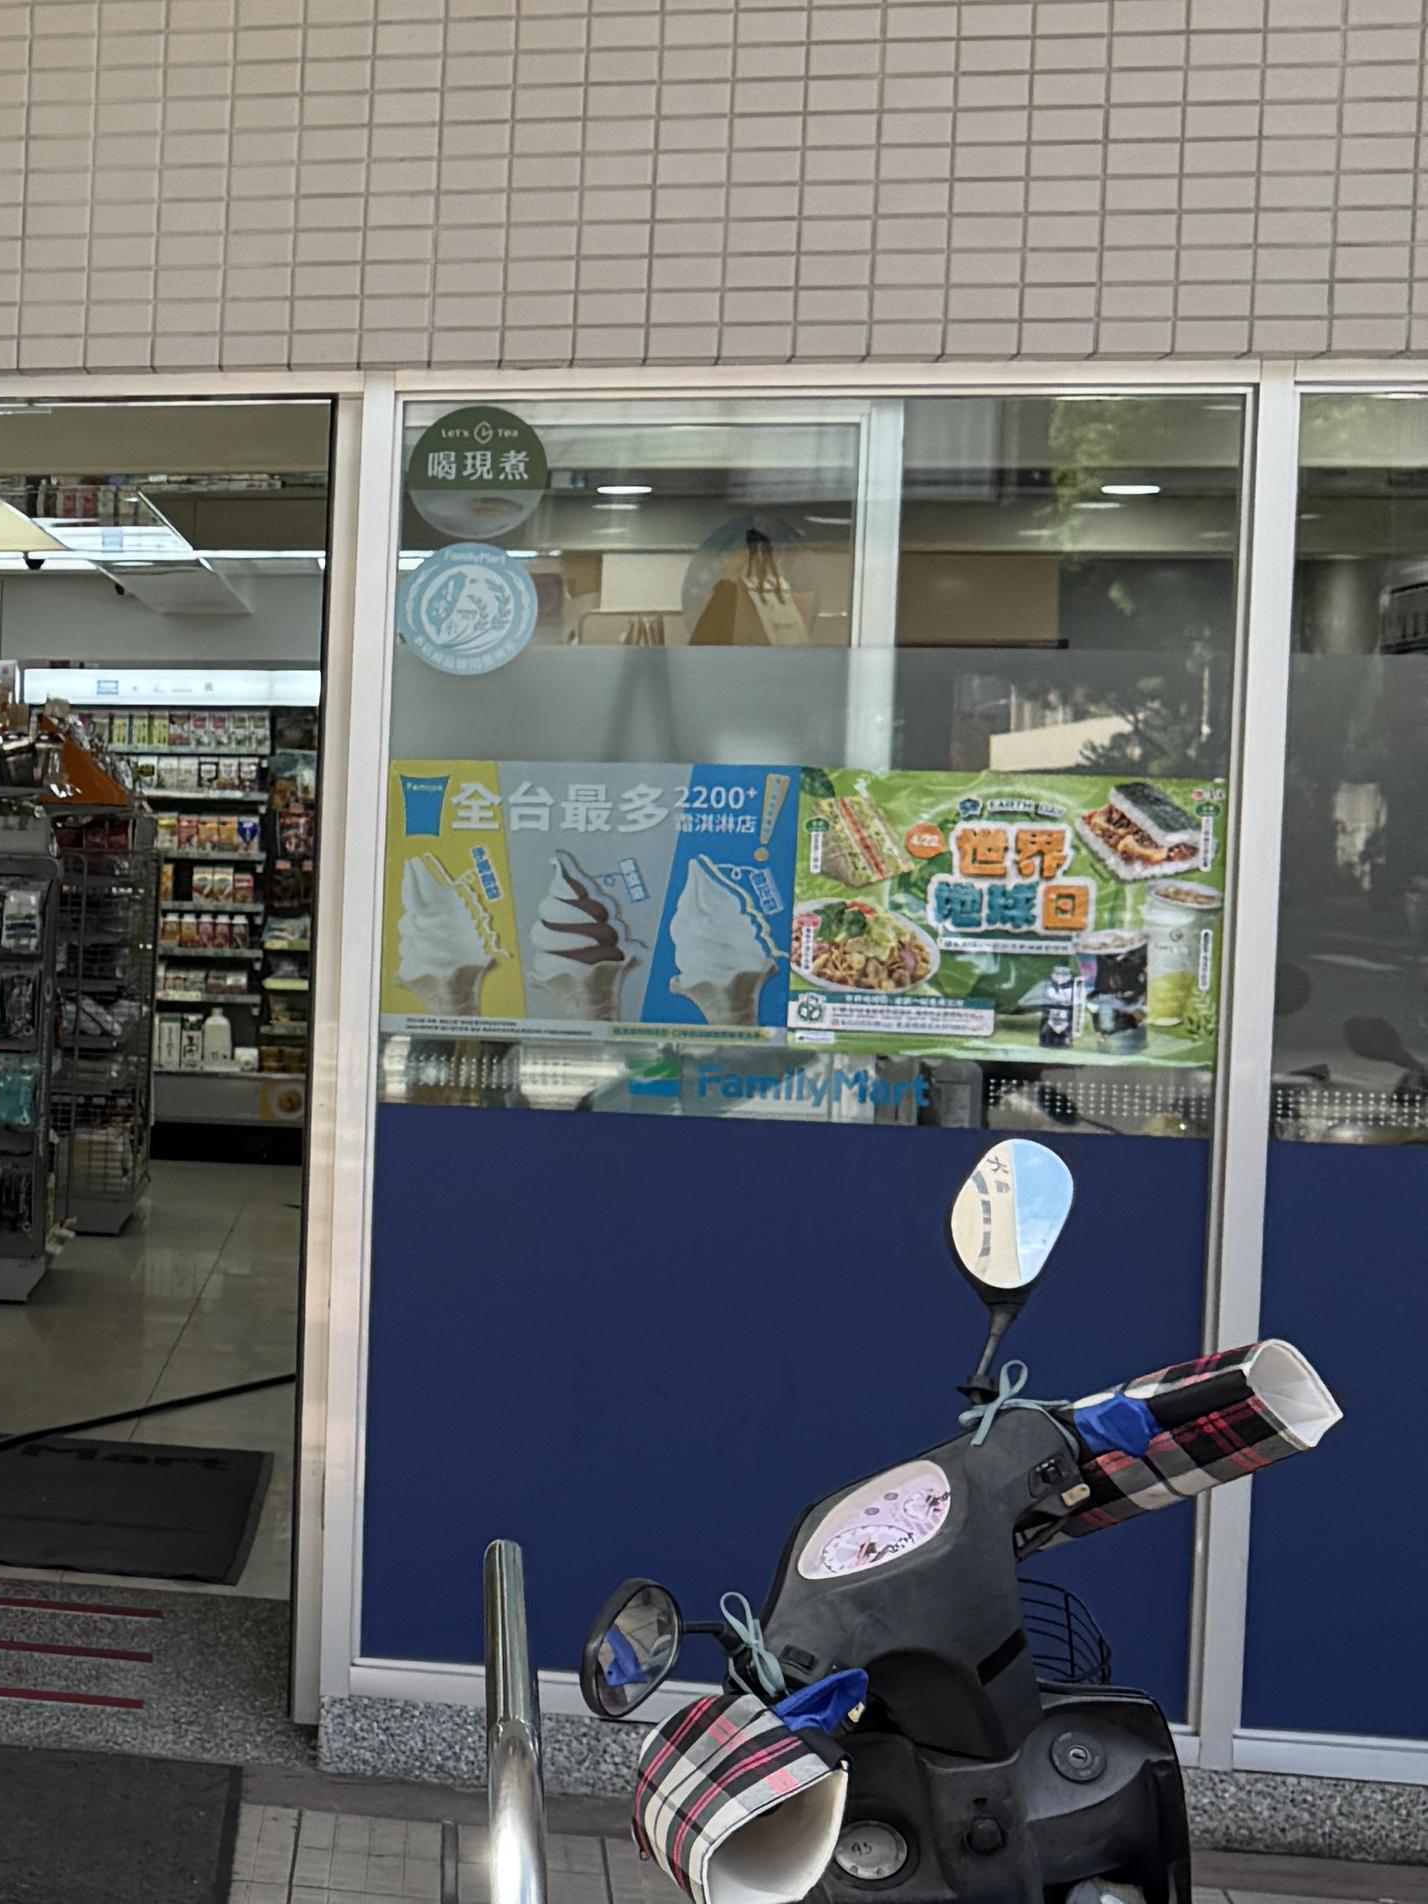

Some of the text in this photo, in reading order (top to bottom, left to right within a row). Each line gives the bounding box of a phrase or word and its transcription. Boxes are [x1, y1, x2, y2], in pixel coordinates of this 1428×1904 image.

[441, 427, 519, 438] Let's Tea
[427, 449, 530, 481] 喝現煮
[451, 780, 758, 834] 全台最多 2200+
[955, 827, 1068, 879] 世界
[698, 1061, 931, 1108] FamilyMart
